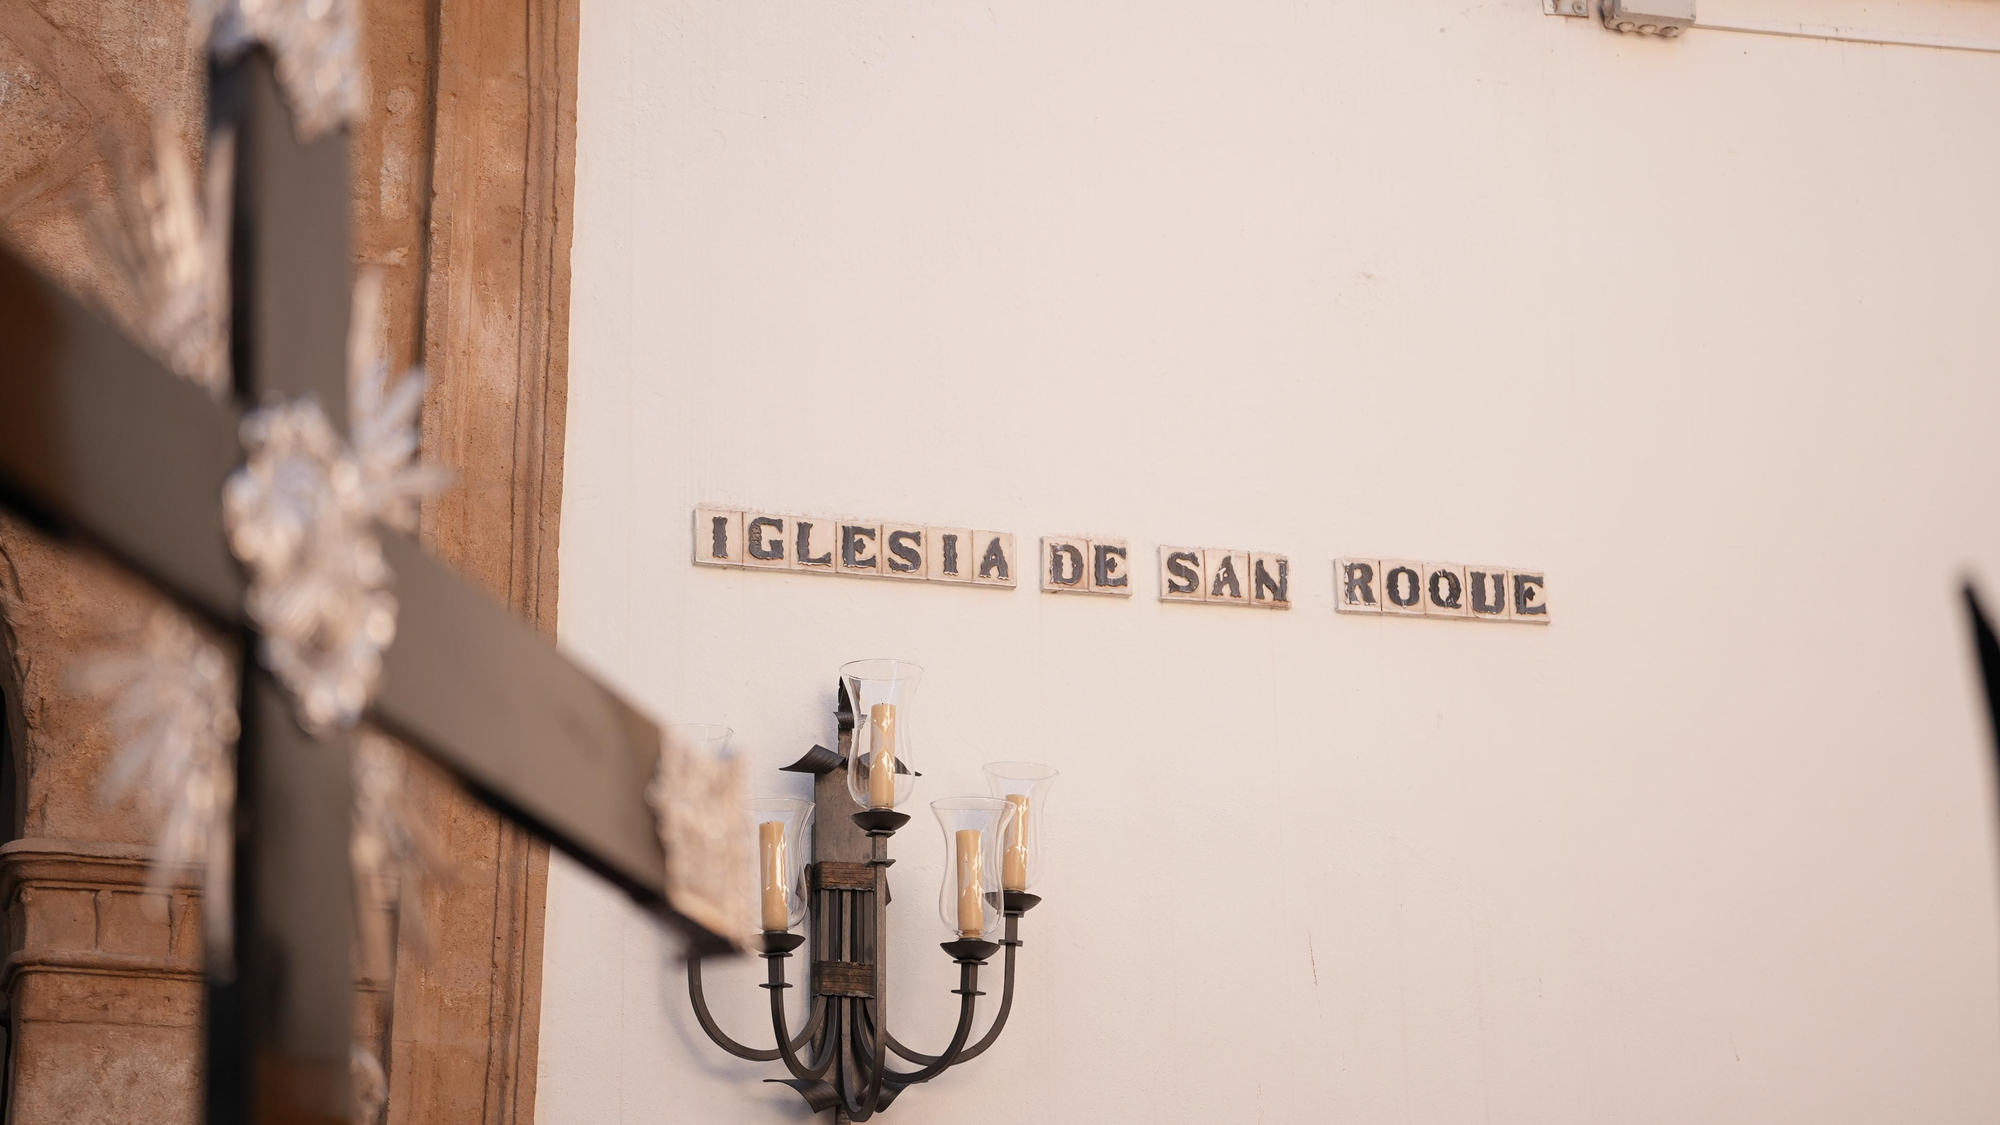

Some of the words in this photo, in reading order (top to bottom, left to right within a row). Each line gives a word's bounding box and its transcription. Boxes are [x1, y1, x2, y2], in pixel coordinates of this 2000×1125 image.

[711, 515, 1009, 580] IGLESIA
[1049, 543, 1128, 588] DE
[1166, 551, 1289, 602] SAN
[1344, 562, 1548, 615] ROQUE
